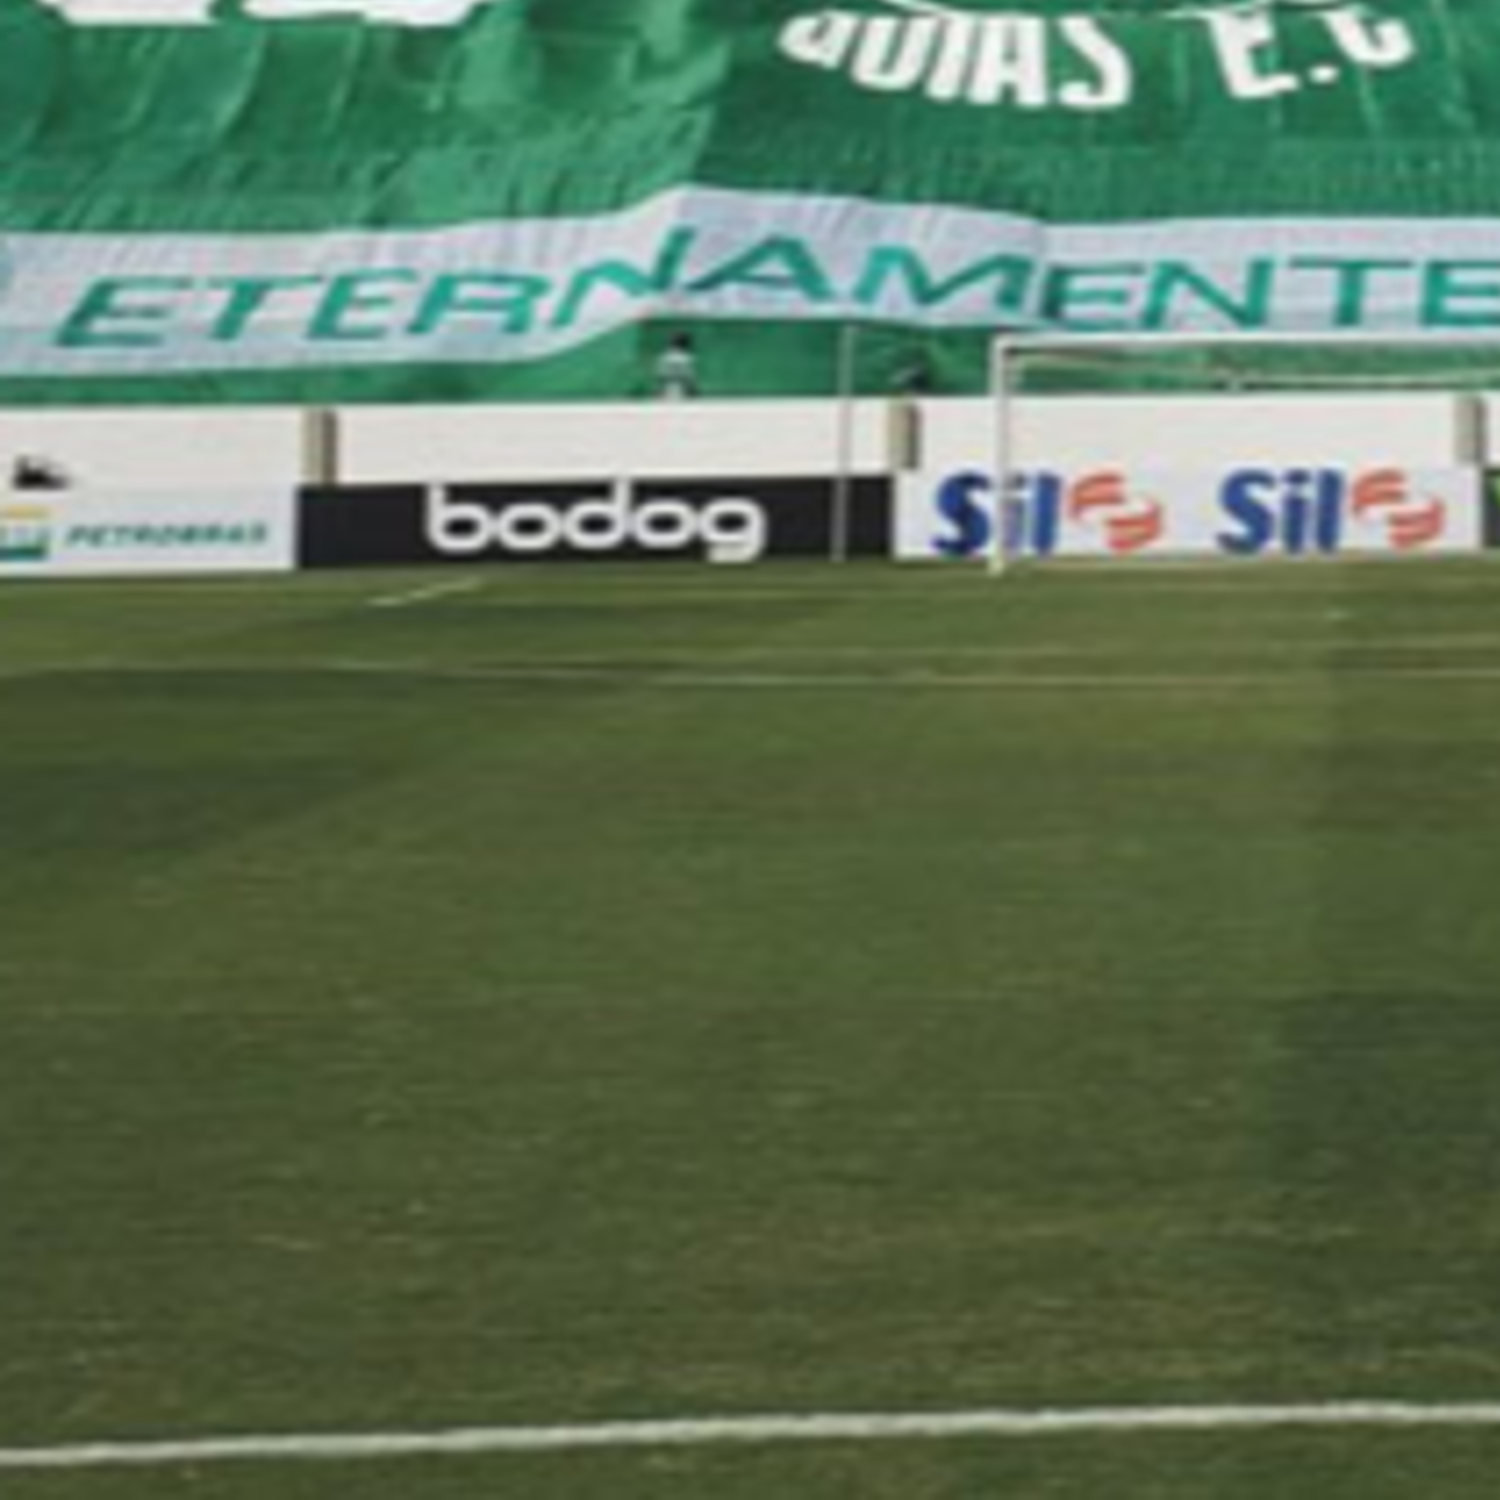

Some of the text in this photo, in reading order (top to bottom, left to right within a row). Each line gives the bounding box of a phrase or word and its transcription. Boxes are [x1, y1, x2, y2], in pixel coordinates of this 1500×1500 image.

[426, 478, 767, 563] bodog
[931, 470, 1062, 557] Sil
[1214, 467, 1344, 557] Sil
